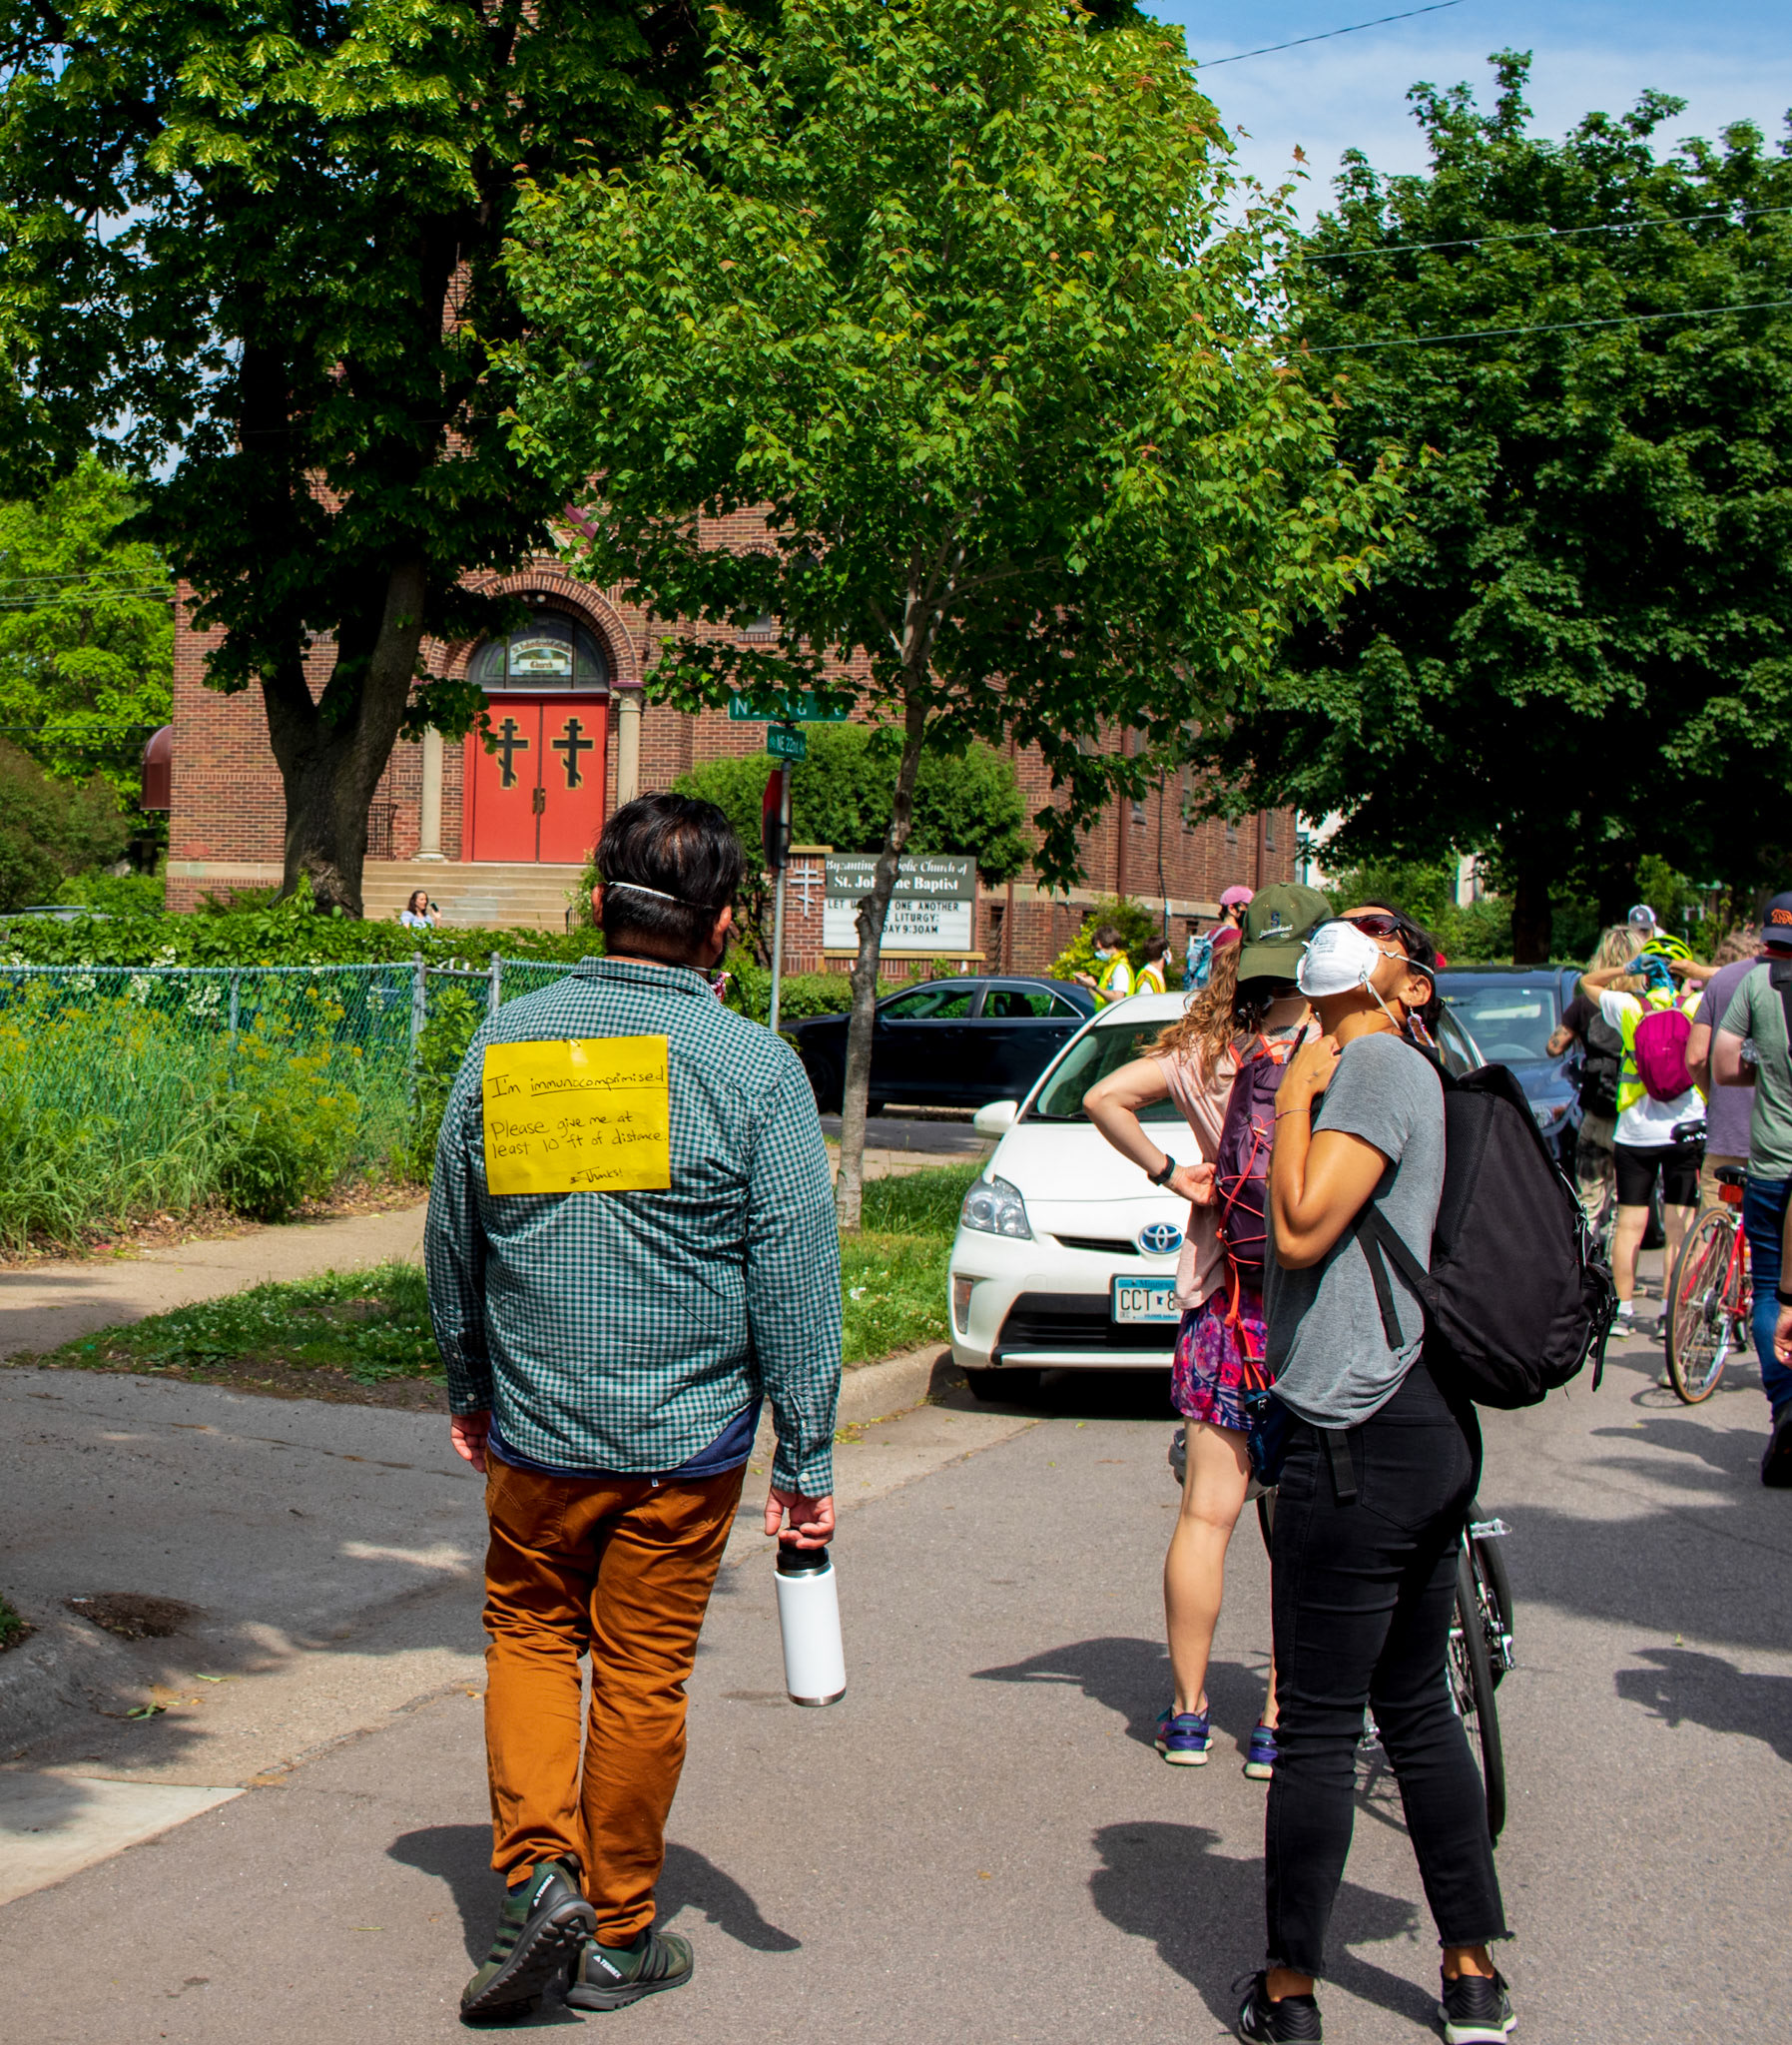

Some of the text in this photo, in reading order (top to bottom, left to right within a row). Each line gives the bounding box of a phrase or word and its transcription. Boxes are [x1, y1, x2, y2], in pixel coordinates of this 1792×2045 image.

[920, 860, 955, 873] Church
[957, 863, 967, 876] of
[834, 876, 853, 888] St.
[855, 875, 877, 888] Joh
[913, 877, 958, 893] Baptist
[828, 900, 844, 909] LET
[895, 901, 911, 911] ONE
[917, 902, 958, 912] ANOTHER
[895, 913, 939, 923] LITURGY:
[902, 925, 938, 935] 9:30AM
[486, 1073, 521, 1098] I'm
[490, 1109, 634, 1140] Please give me at
[492, 1140, 532, 1158] least
[542, 1138, 560, 1152] 10
[566, 1133, 584, 1149] ft
[591, 1130, 604, 1145] of
[1120, 1289, 1152, 1311] CCT
